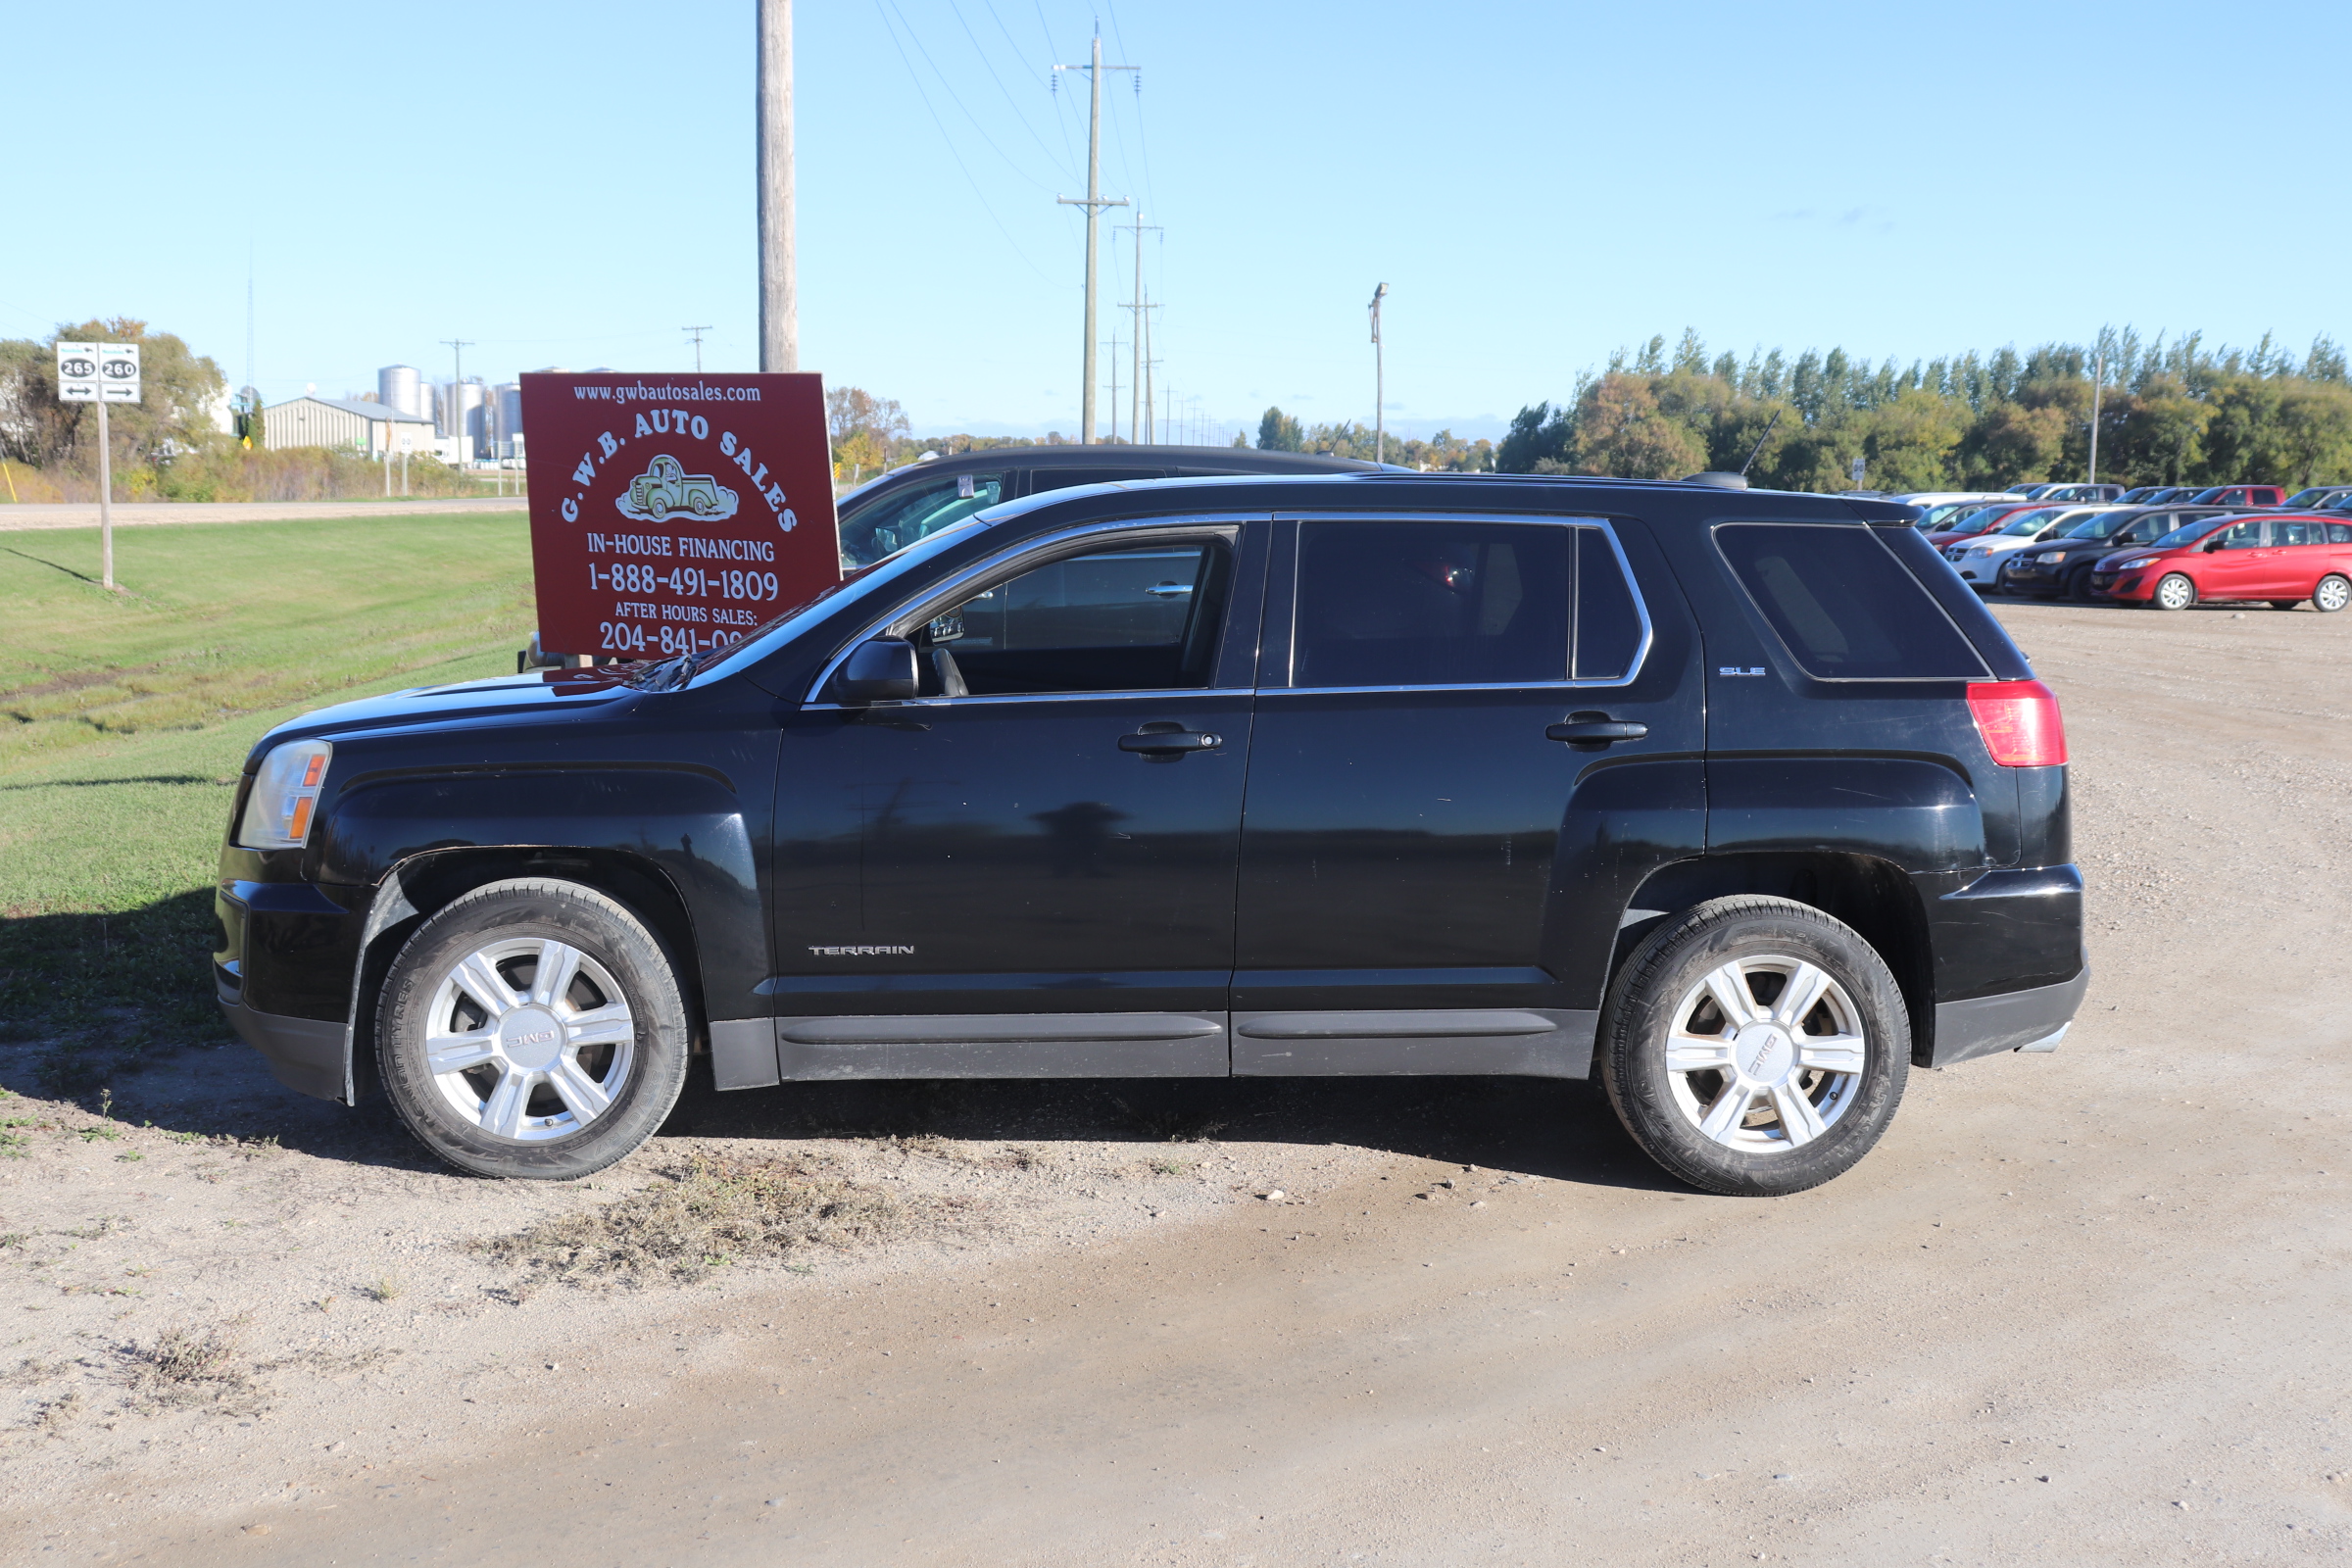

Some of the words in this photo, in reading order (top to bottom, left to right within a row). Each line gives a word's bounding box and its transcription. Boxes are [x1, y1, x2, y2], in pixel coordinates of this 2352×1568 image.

[64, 362, 93, 375] 265
[104, 363, 135, 376] 260
[573, 379, 761, 404] www.gwbautosales.com
[561, 430, 626, 523] G.W.B.
[634, 408, 710, 440] AUTO
[719, 431, 798, 532] SALES
[587, 532, 672, 557] IN-HOUSE
[677, 537, 775, 563] FINANCING
[588, 562, 779, 602] 1-888-491-1809
[614, 601, 658, 619] AFTER
[662, 604, 708, 623] HOURS
[711, 608, 758, 626] SALES:
[1719, 666, 1766, 676] SLE
[808, 945, 914, 956] TERRAIN
[507, 1030, 555, 1048] GMC
[1748, 1032, 1780, 1076] GMC
